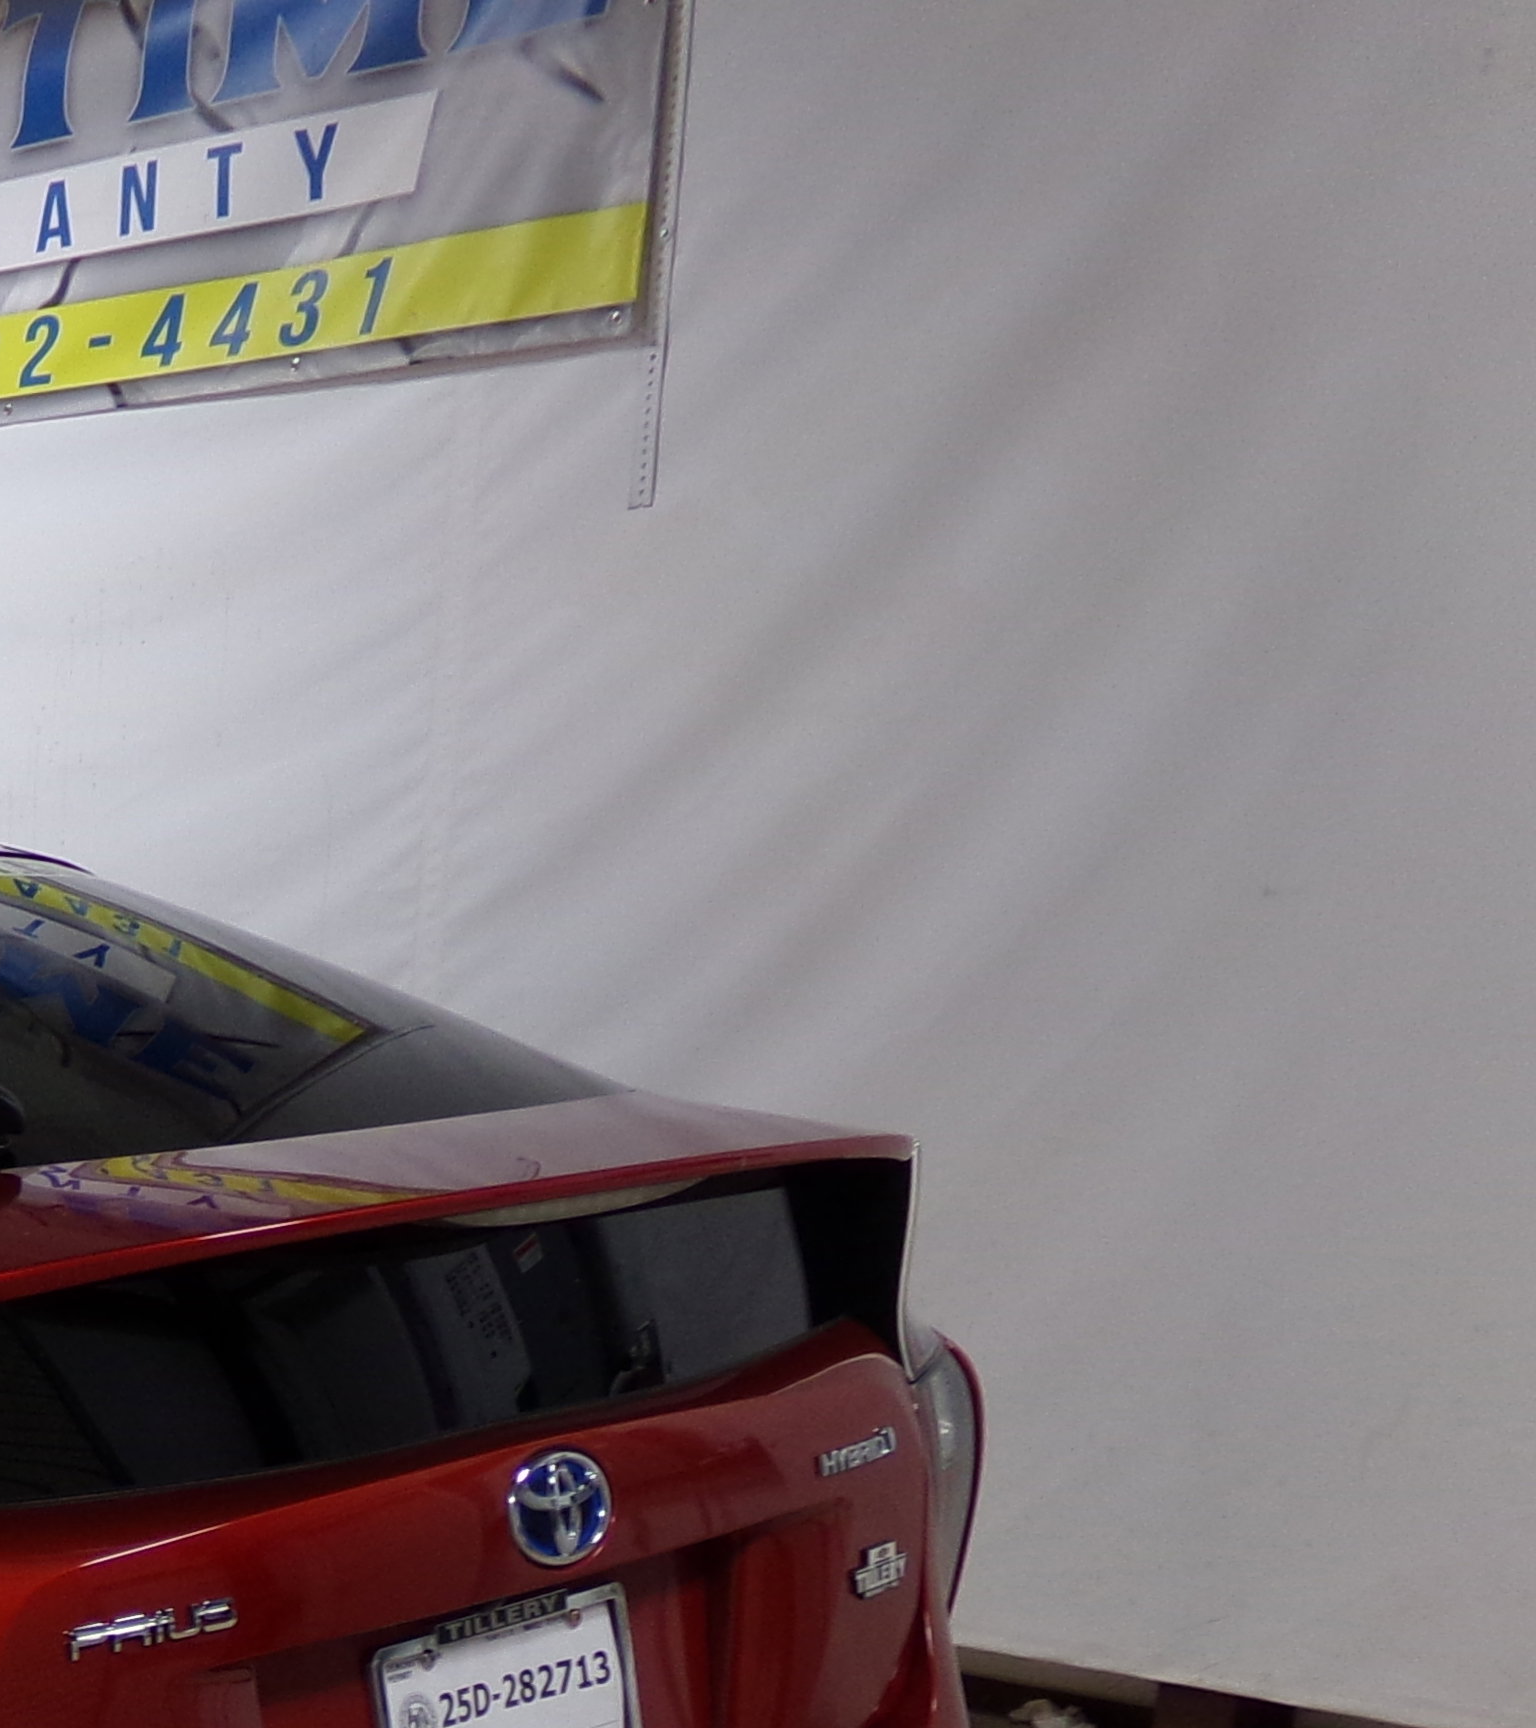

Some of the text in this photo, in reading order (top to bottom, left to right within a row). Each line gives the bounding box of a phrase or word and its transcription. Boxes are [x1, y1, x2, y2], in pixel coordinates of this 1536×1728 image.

[62, 1597, 238, 1661] PRIUS
[445, 1595, 559, 1641] TILLERY
[438, 1649, 612, 1728] 25D-282713
